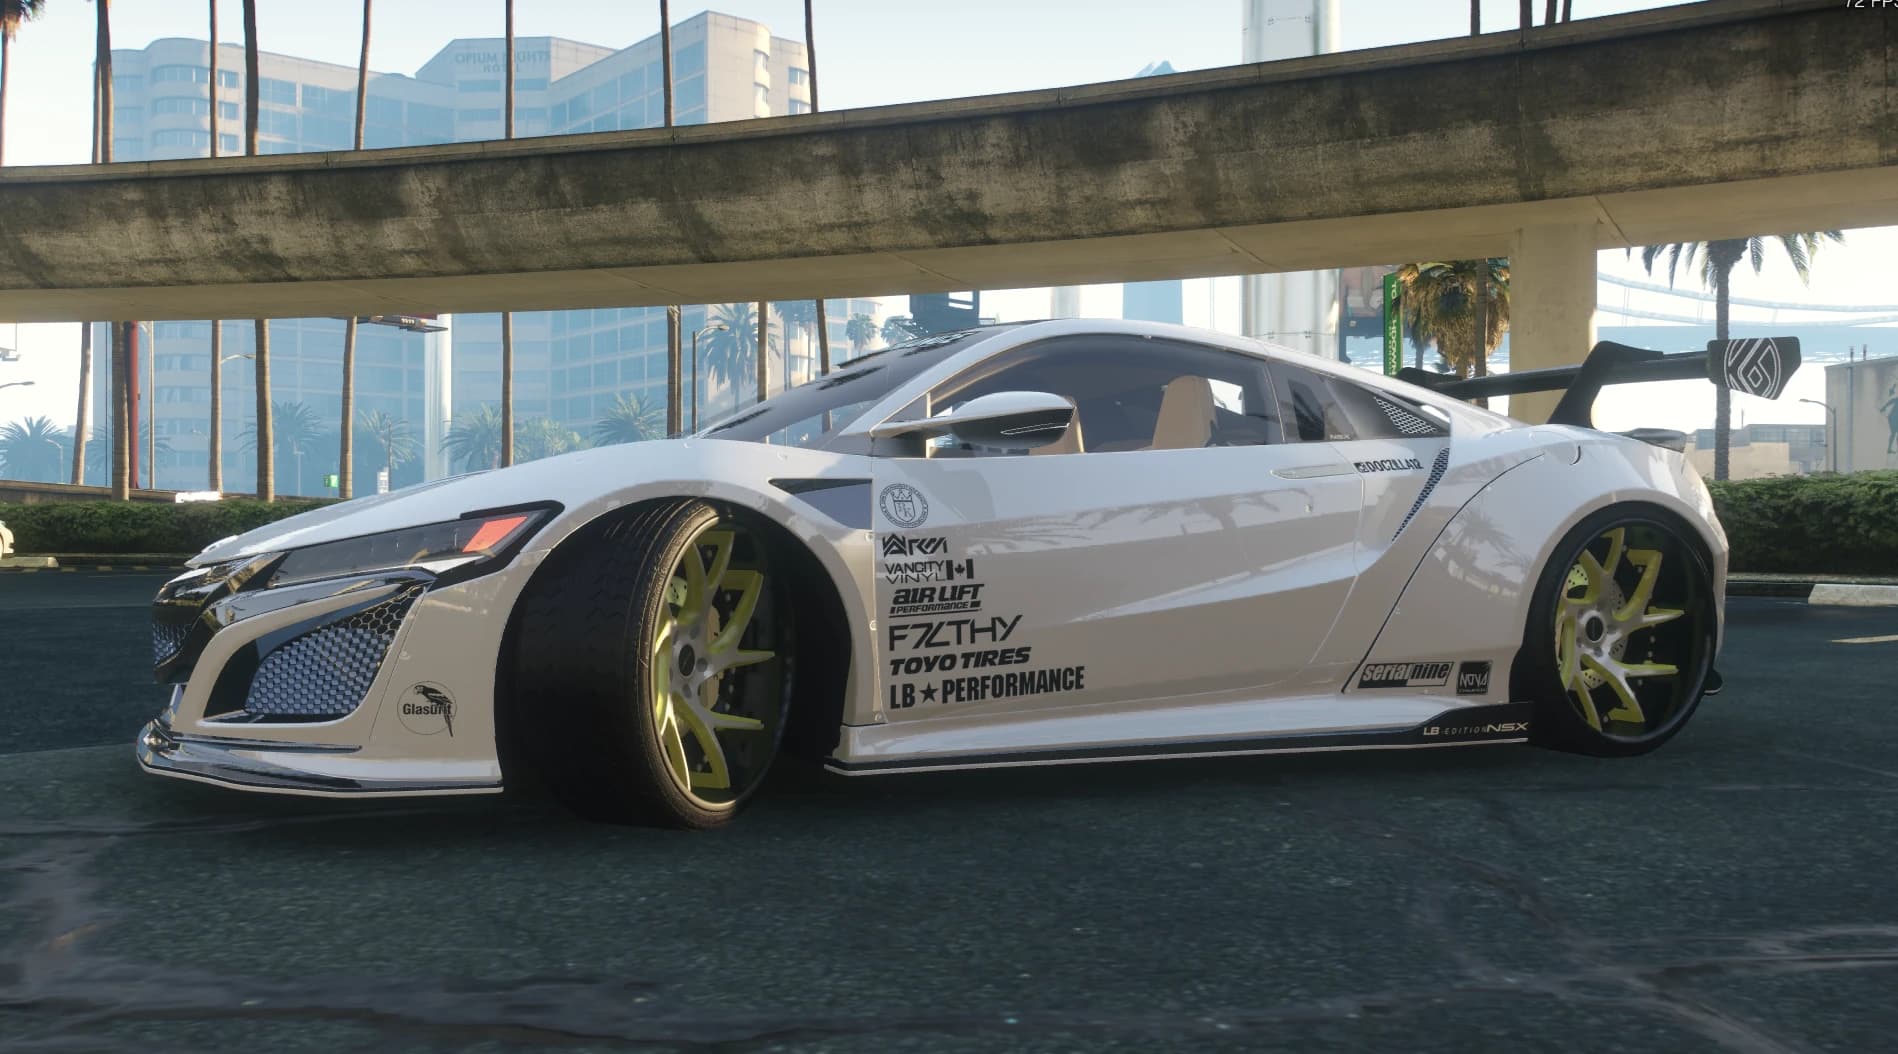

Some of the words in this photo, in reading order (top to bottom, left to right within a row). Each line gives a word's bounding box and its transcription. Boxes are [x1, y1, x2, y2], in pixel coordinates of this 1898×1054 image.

[885, 560, 944, 575] VANCITY
[885, 572, 946, 584] VINYL
[938, 584, 985, 602] LIFT
[890, 653, 957, 676] TOYO
[961, 646, 1032, 669] TIRES
[890, 682, 916, 710] LB
[942, 666, 1085, 704] PERFORMANCE
[1423, 726, 1440, 736] LB
[1444, 726, 1487, 736] EDITION
[1486, 722, 1529, 733] NSX
